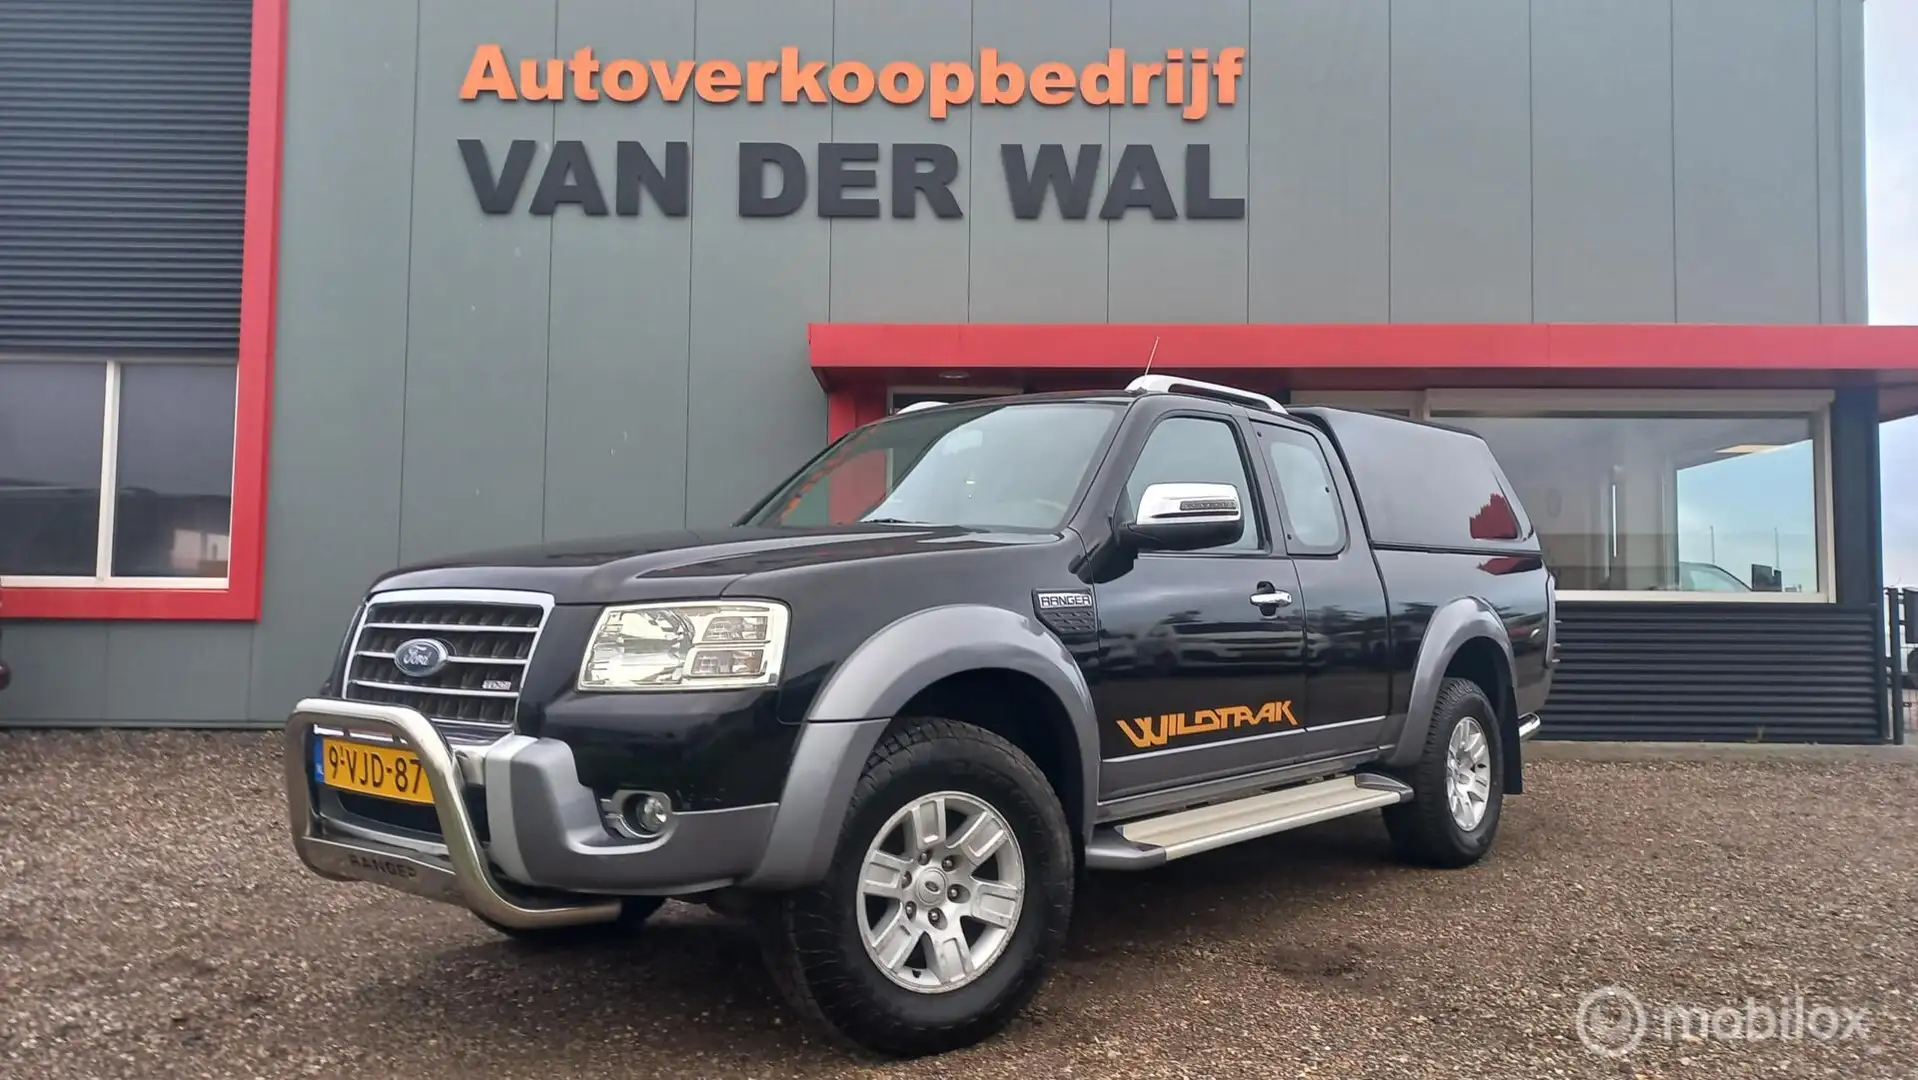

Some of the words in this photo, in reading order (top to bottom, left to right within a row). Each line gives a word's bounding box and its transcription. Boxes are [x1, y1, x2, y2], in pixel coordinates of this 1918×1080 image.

[459, 44, 1245, 121] Autoverkoopbedrijf
[457, 138, 689, 217] VAN
[738, 141, 964, 219] DER
[1001, 143, 1246, 220] WAL
[1040, 595, 1091, 606] RANGER
[403, 645, 432, 666] Ford
[1116, 700, 1299, 748] WILDTRAK
[328, 745, 423, 794] 9-VJD-87
